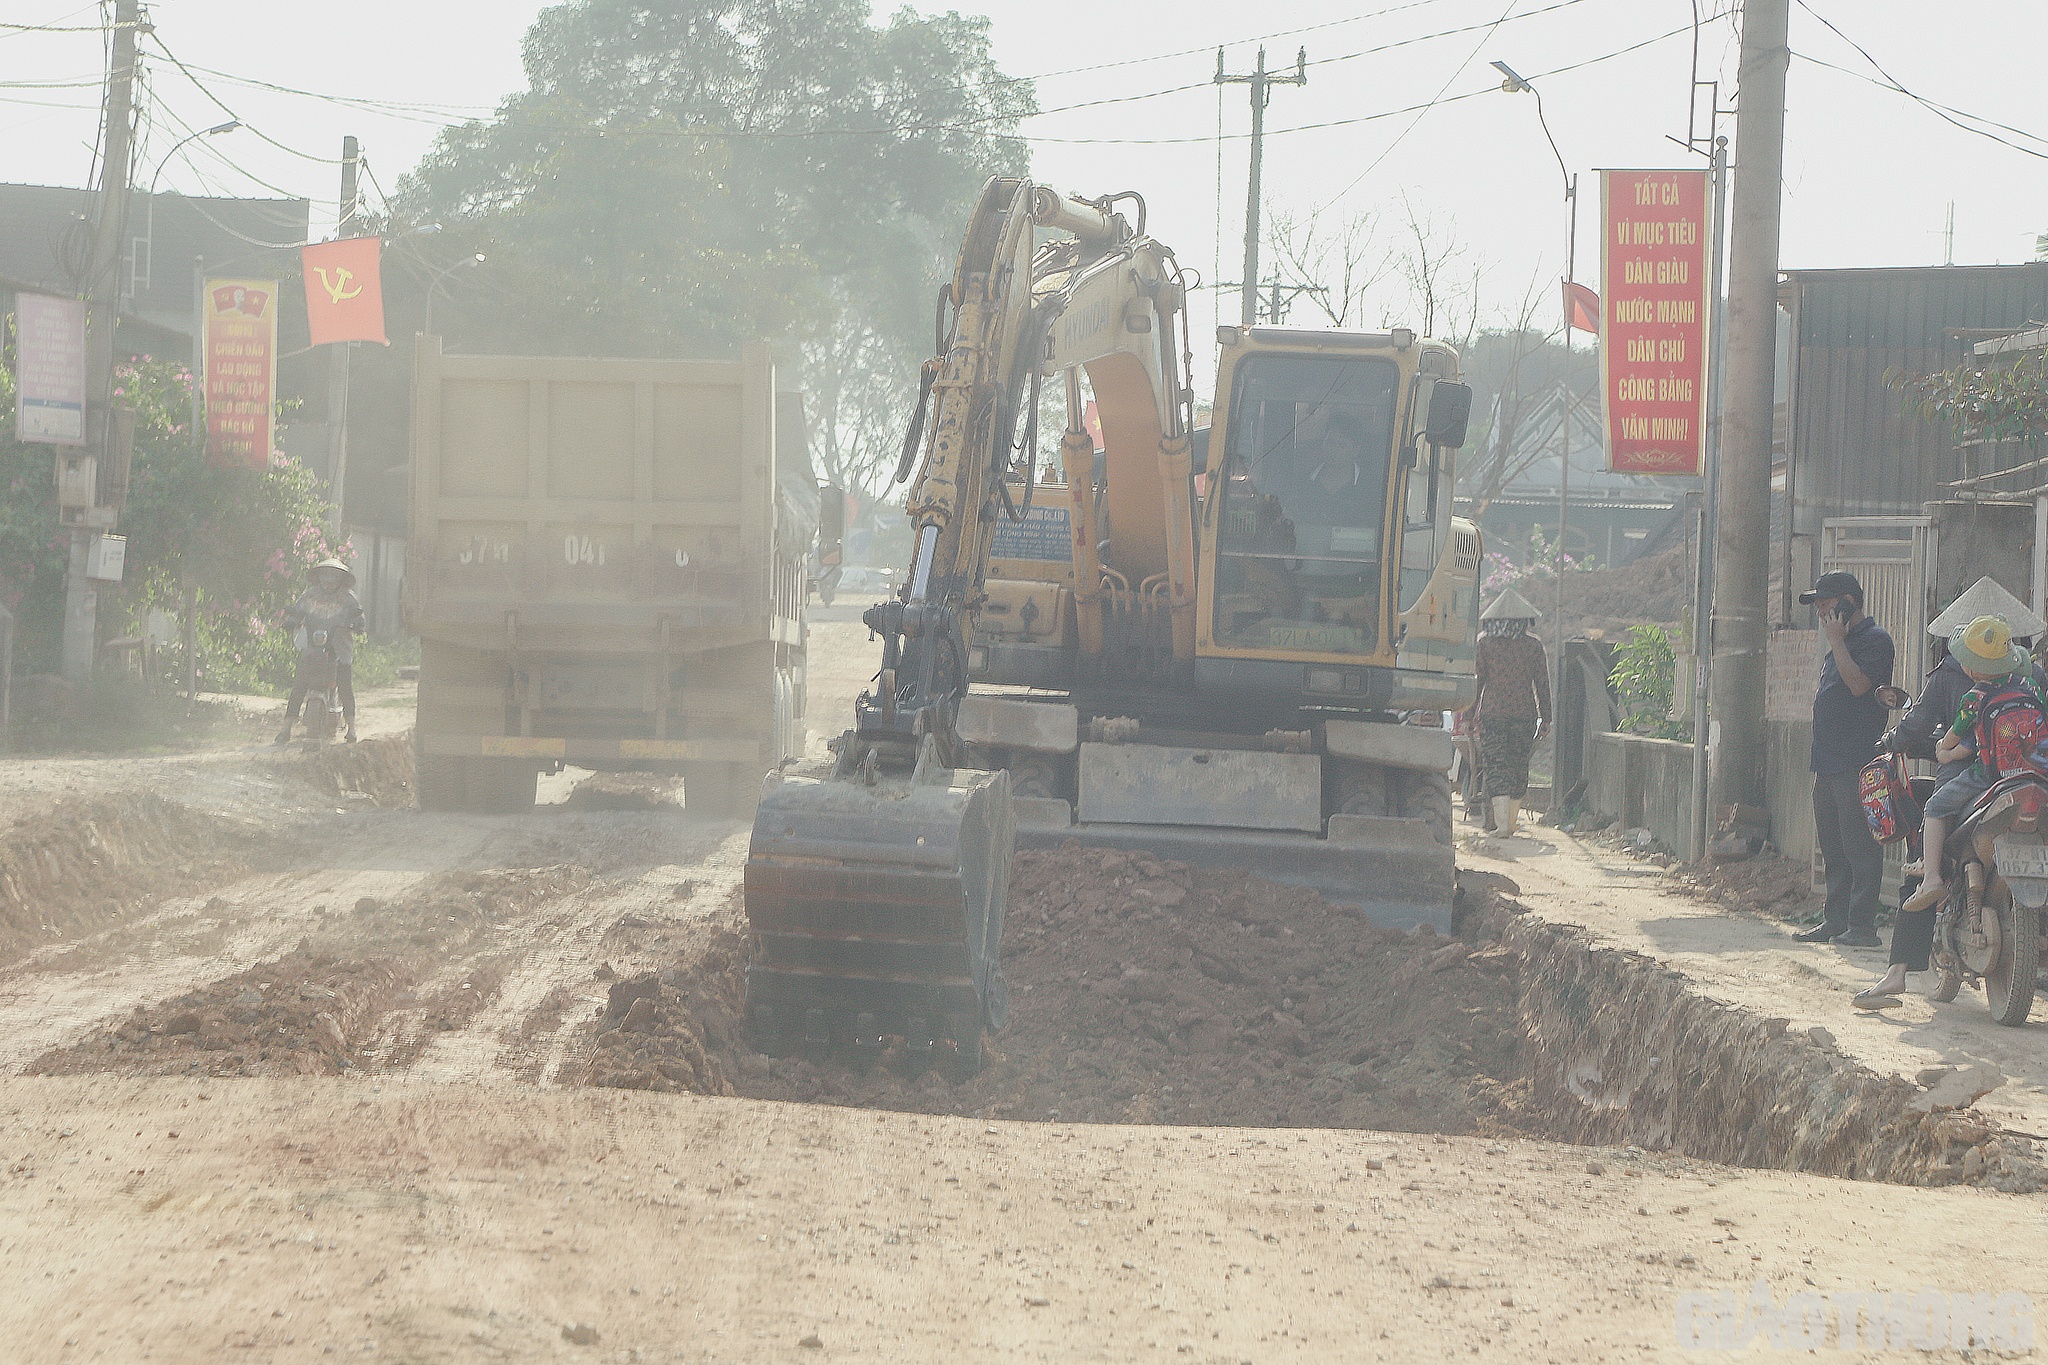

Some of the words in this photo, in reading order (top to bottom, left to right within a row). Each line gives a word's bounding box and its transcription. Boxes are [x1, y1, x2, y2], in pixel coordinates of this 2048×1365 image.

[1634, 175, 1658, 206] TẤT
[1661, 175, 1680, 206] CẢ
[1617, 217, 1631, 245] VÌ
[1633, 221, 1664, 250] MỤC
[1668, 217, 1697, 246] TIÊU
[1625, 256, 1653, 284] DÂN
[1656, 256, 1689, 285] GIÀU
[1064, 296, 1110, 351] HYUNDAI
[1616, 298, 1653, 324] NƯỚC
[1657, 299, 1695, 328] MẠNH
[1627, 335, 1655, 363] DÂN
[1659, 332, 1685, 363] CHỦ
[1618, 374, 1655, 402] CÔNG
[1658, 371, 1692, 402] BẰNG
[1621, 413, 1648, 440] VĂN
[1651, 417, 1689, 441] MINH!
